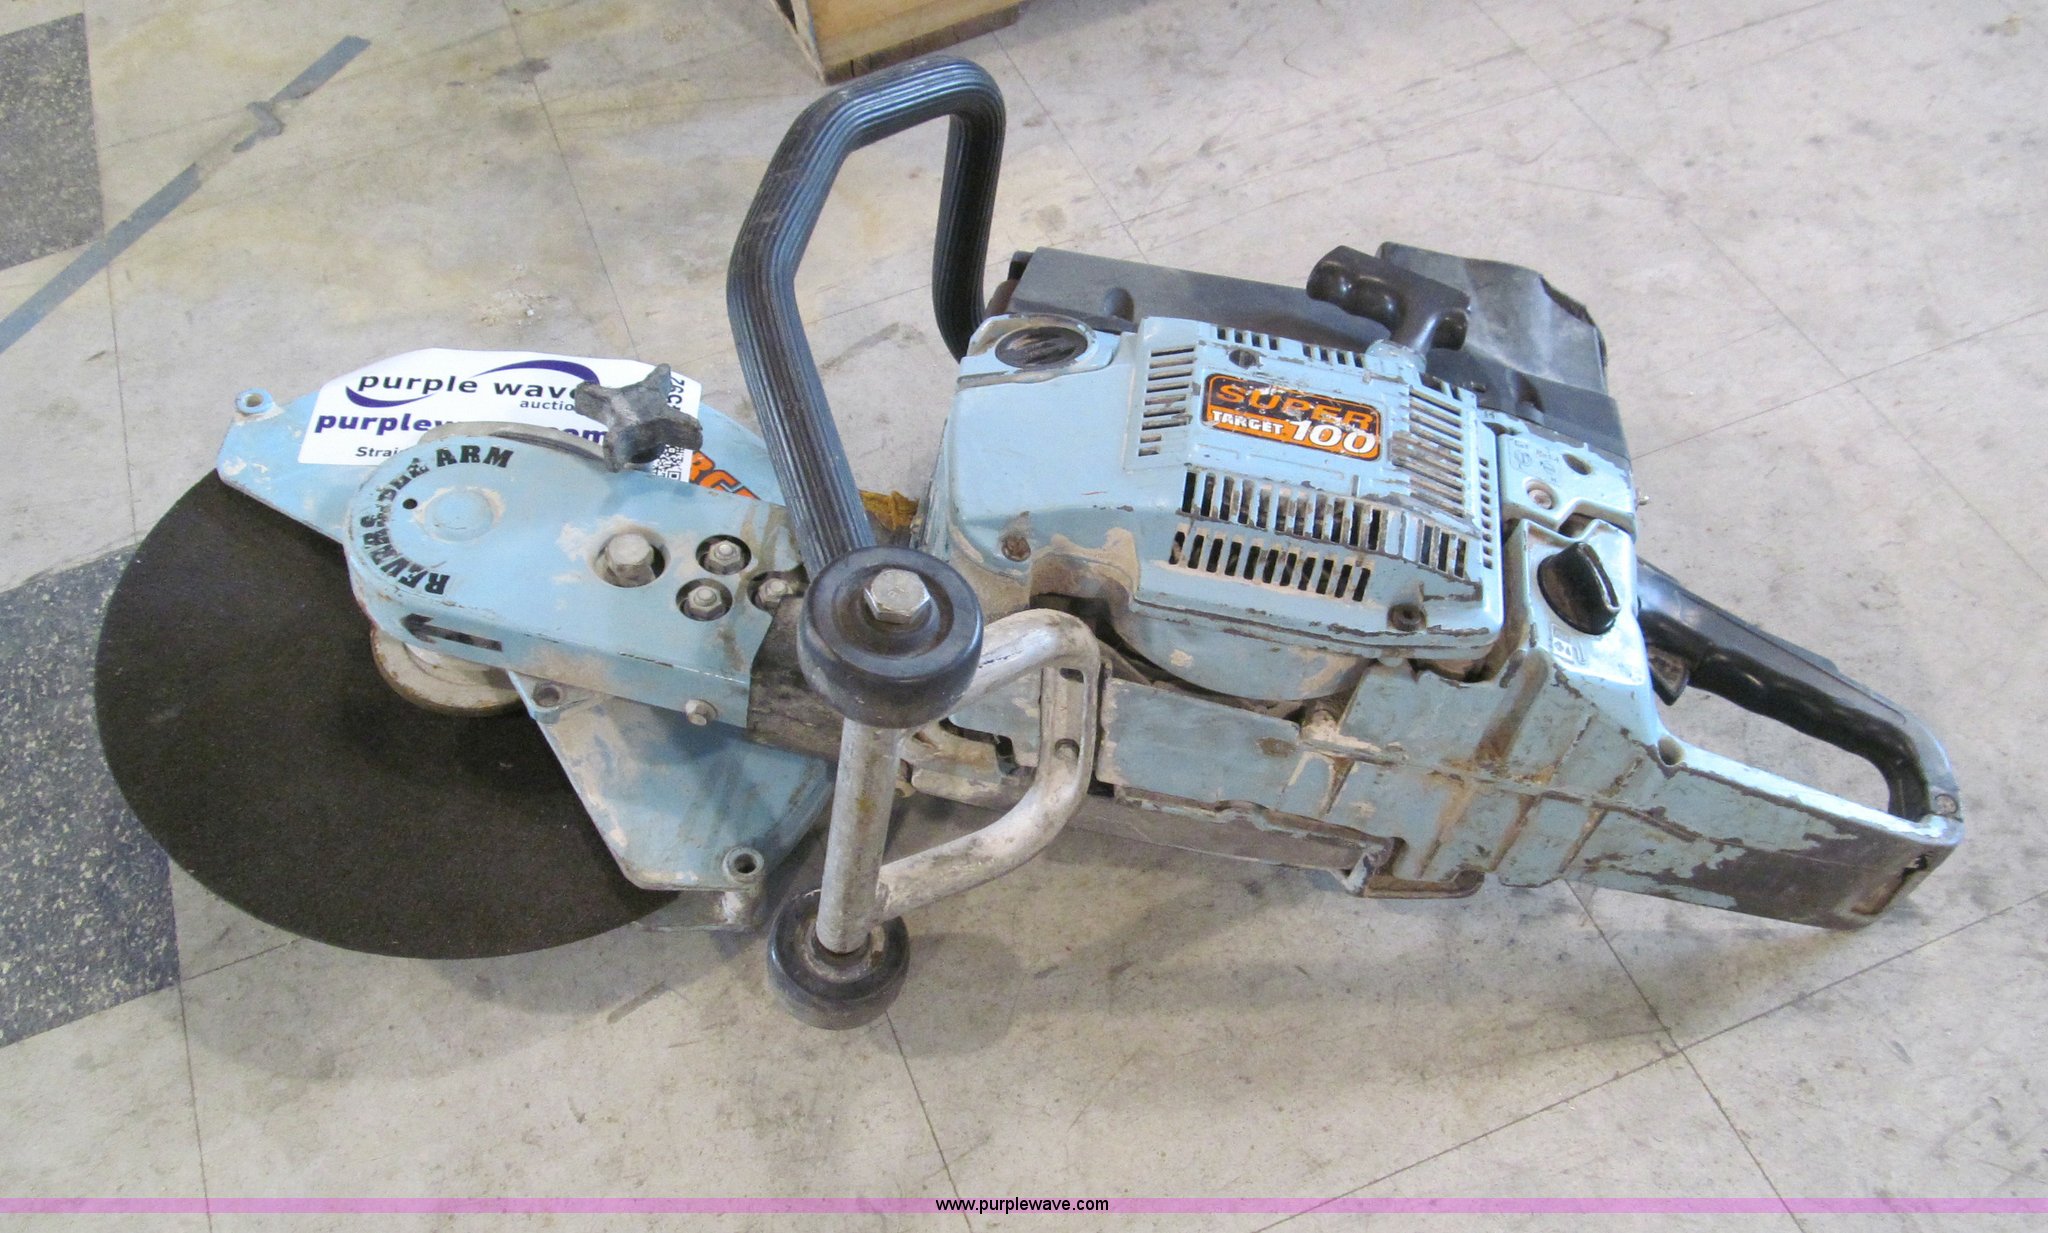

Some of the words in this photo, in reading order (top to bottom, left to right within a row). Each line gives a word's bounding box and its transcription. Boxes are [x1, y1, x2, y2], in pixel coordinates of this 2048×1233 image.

[358, 375, 478, 395] purple
[494, 382, 576, 399] wav
[520, 400, 575, 412] auctio
[1216, 384, 1375, 432] SUPER
[1212, 410, 1284, 435] TARGET
[1287, 418, 1376, 454] 100
[355, 446, 400, 457] Strai
[436, 445, 514, 468] ARM
